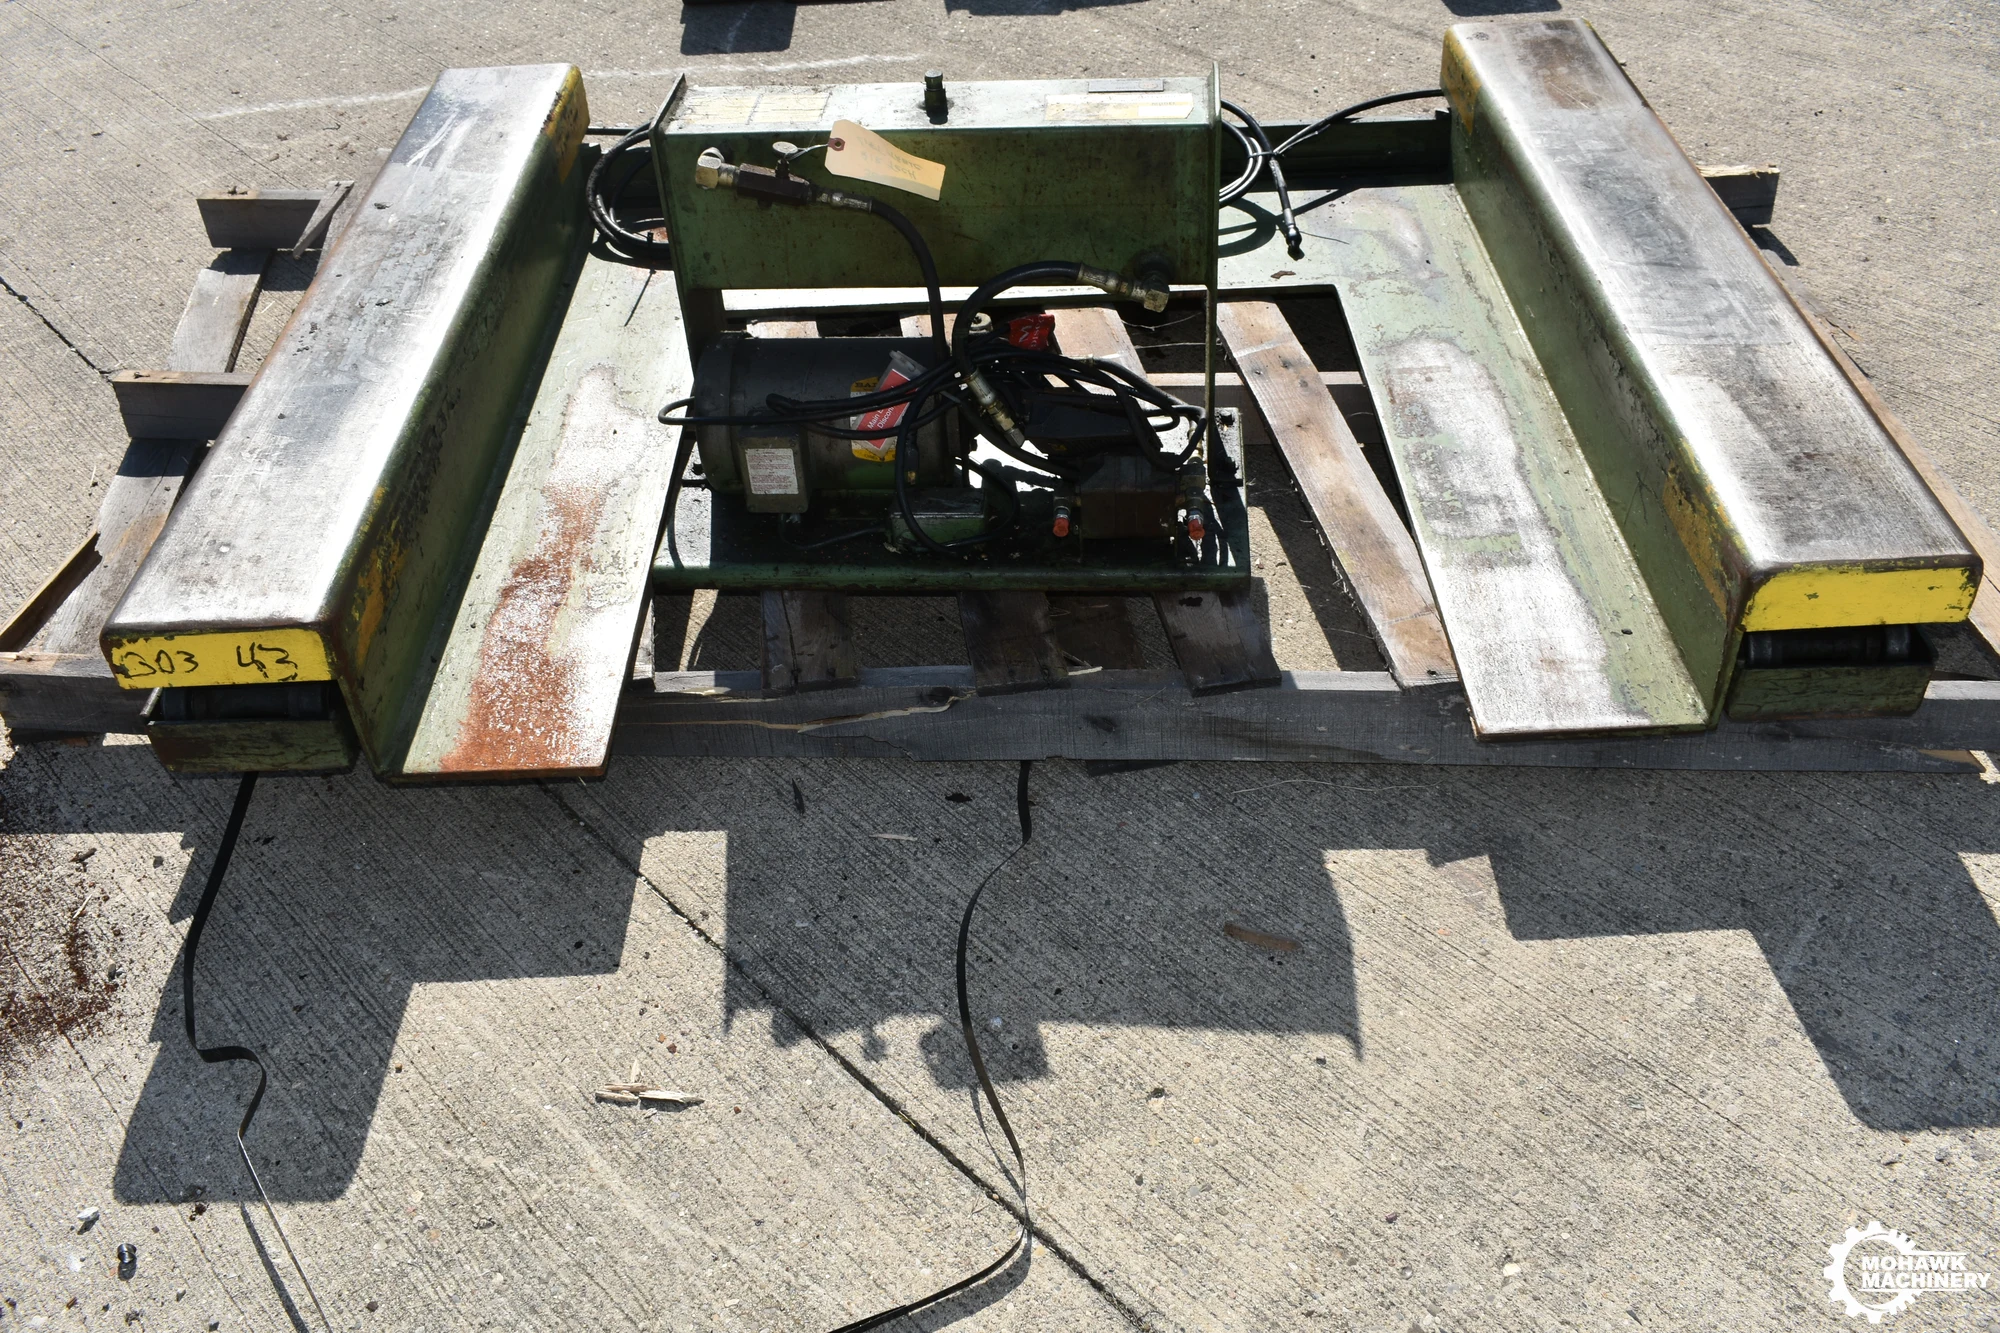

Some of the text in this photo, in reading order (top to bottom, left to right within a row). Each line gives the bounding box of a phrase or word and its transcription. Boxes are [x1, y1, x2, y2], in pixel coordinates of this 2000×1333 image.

[867, 414, 880, 430] Main
[876, 406, 895, 429] Discon
[236, 642, 298, 682] 43
